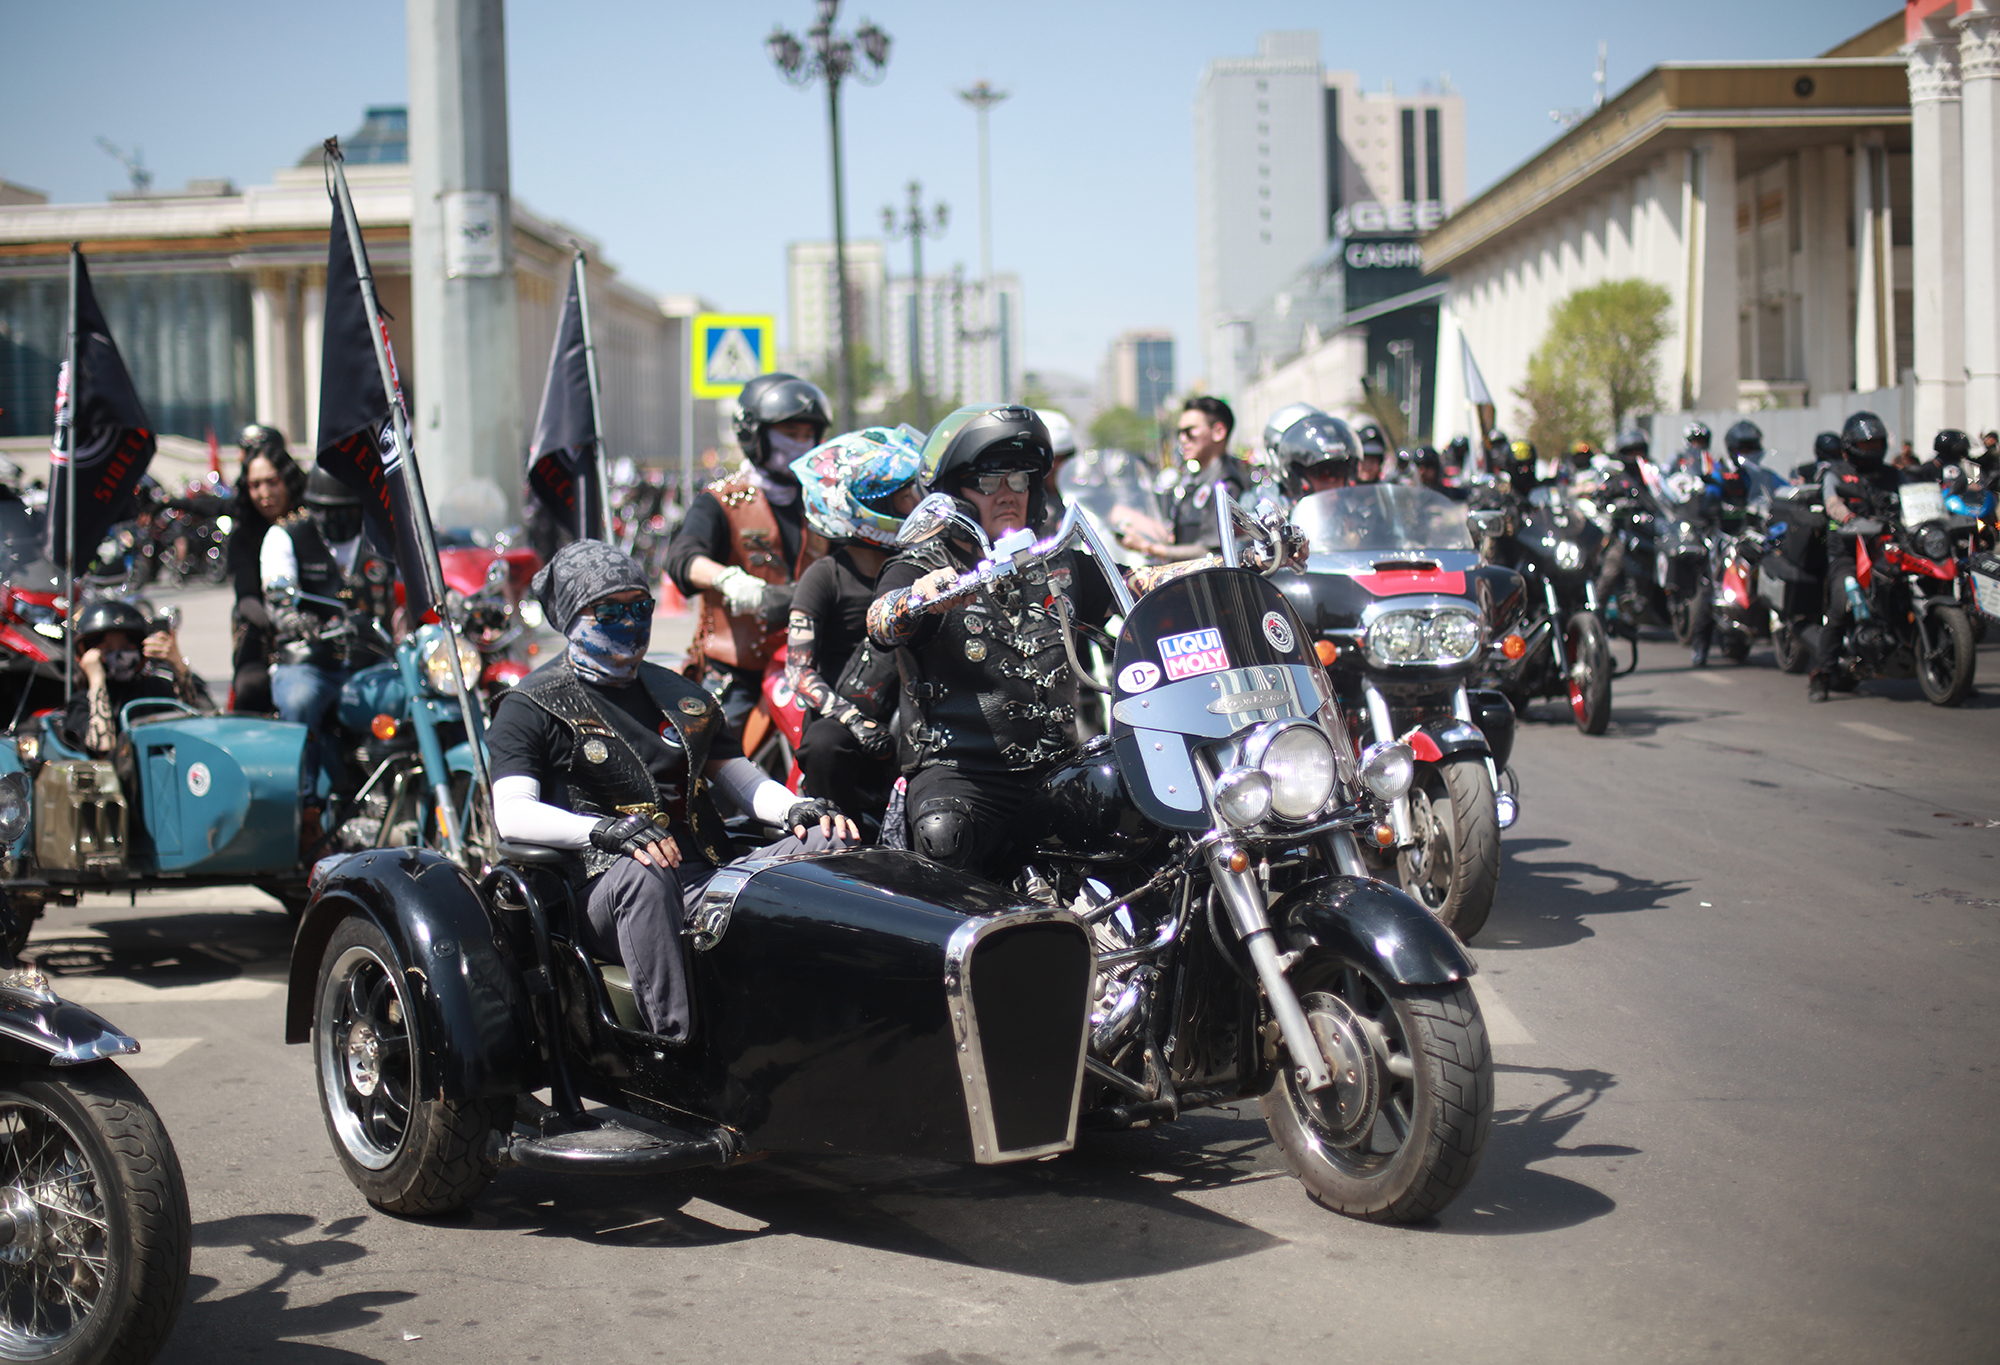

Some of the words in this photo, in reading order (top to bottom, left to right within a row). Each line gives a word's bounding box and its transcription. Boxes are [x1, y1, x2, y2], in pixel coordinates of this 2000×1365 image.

[1351, 200, 1453, 231] GEE
[1162, 631, 1220, 659] LIQUI
[1168, 649, 1223, 677] MOLY
[1132, 669, 1146, 686] D
